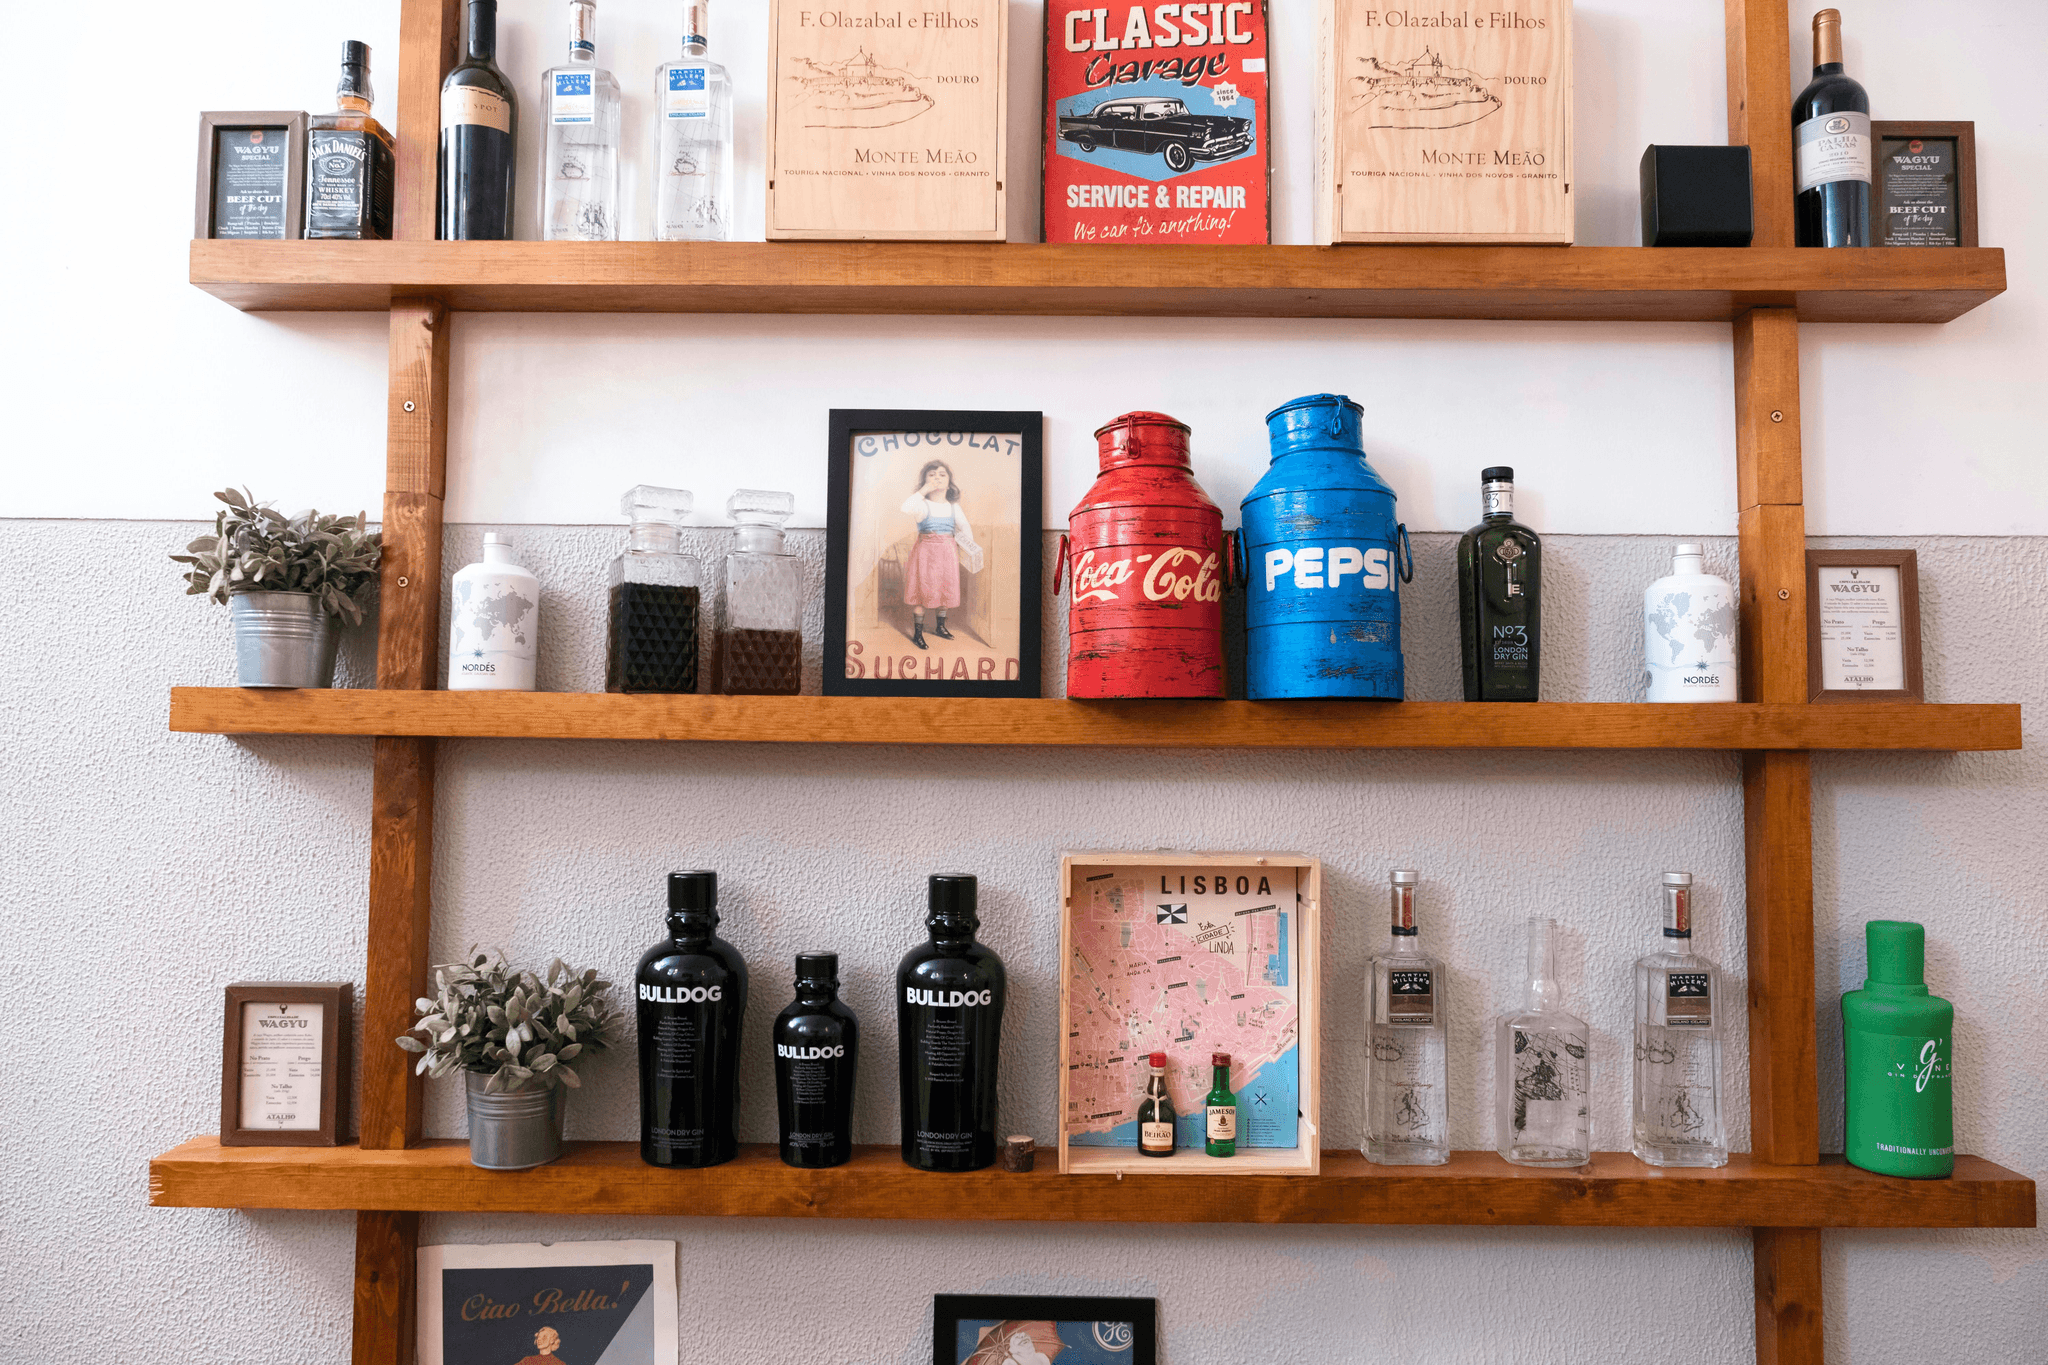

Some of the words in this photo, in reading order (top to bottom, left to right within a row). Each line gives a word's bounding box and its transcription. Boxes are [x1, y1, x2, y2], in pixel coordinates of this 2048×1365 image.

[800, 11, 815, 27] F.
[819, 12, 901, 28] Olazabal
[908, 18, 918, 28] e
[923, 12, 979, 28] Filhos
[1064, 2, 1253, 52] CLASSIC
[1366, 10, 1380, 27] F.
[1385, 11, 1468, 28] Olazabal
[1474, 18, 1484, 28] e
[1489, 12, 1546, 28] Filhos
[1085, 52, 1230, 88] Garage
[937, 75, 980, 84] DOURO
[1504, 76, 1546, 85] DOURO
[234, 146, 280, 154] WAGYU
[311, 143, 332, 160] JACK
[854, 148, 919, 164] MONTE
[926, 148, 978, 164] MEÃO
[1422, 149, 1486, 166] MONTE
[1494, 150, 1545, 166] MEÃO
[226, 196, 256, 204] BEEF
[1066, 184, 1150, 208] SERVICE
[1155, 185, 1170, 208] &
[1176, 186, 1246, 208] REPAIR
[239, 204, 247, 215] of
[258, 204, 268, 215] day
[1074, 221, 1096, 241] We
[1100, 224, 1128, 238] can
[1134, 216, 1154, 238] fix
[1158, 210, 1236, 238] anything!
[1903, 214, 1911, 226] of
[1922, 214, 1933, 226] day
[858, 432, 1020, 458] CHOCOLAT
[1072, 546, 1221, 604] Coca-Cola
[1265, 547, 1396, 592] PEPSI
[462, 662, 496, 672] NORDÉS
[846, 640, 1020, 680] SUCHARD
[1684, 674, 1720, 684] NORDÉS
[1161, 876, 1272, 896] LISBOA
[1198, 929, 1223, 942] CIDADE
[640, 983, 722, 1003] BULLDOG
[906, 986, 991, 1007] BULLDOG
[258, 1020, 308, 1028] WAGYU
[778, 1043, 844, 1060] BULLDOG
[651, 1127, 676, 1136] LONDON
[916, 1130, 944, 1140] LONDON
[1144, 1130, 1171, 1138] BEIRÃO
[1876, 1142, 1926, 1155] TRADITIONALLY
[461, 1293, 520, 1322] Ciao
[528, 1280, 630, 1316] Bella!
